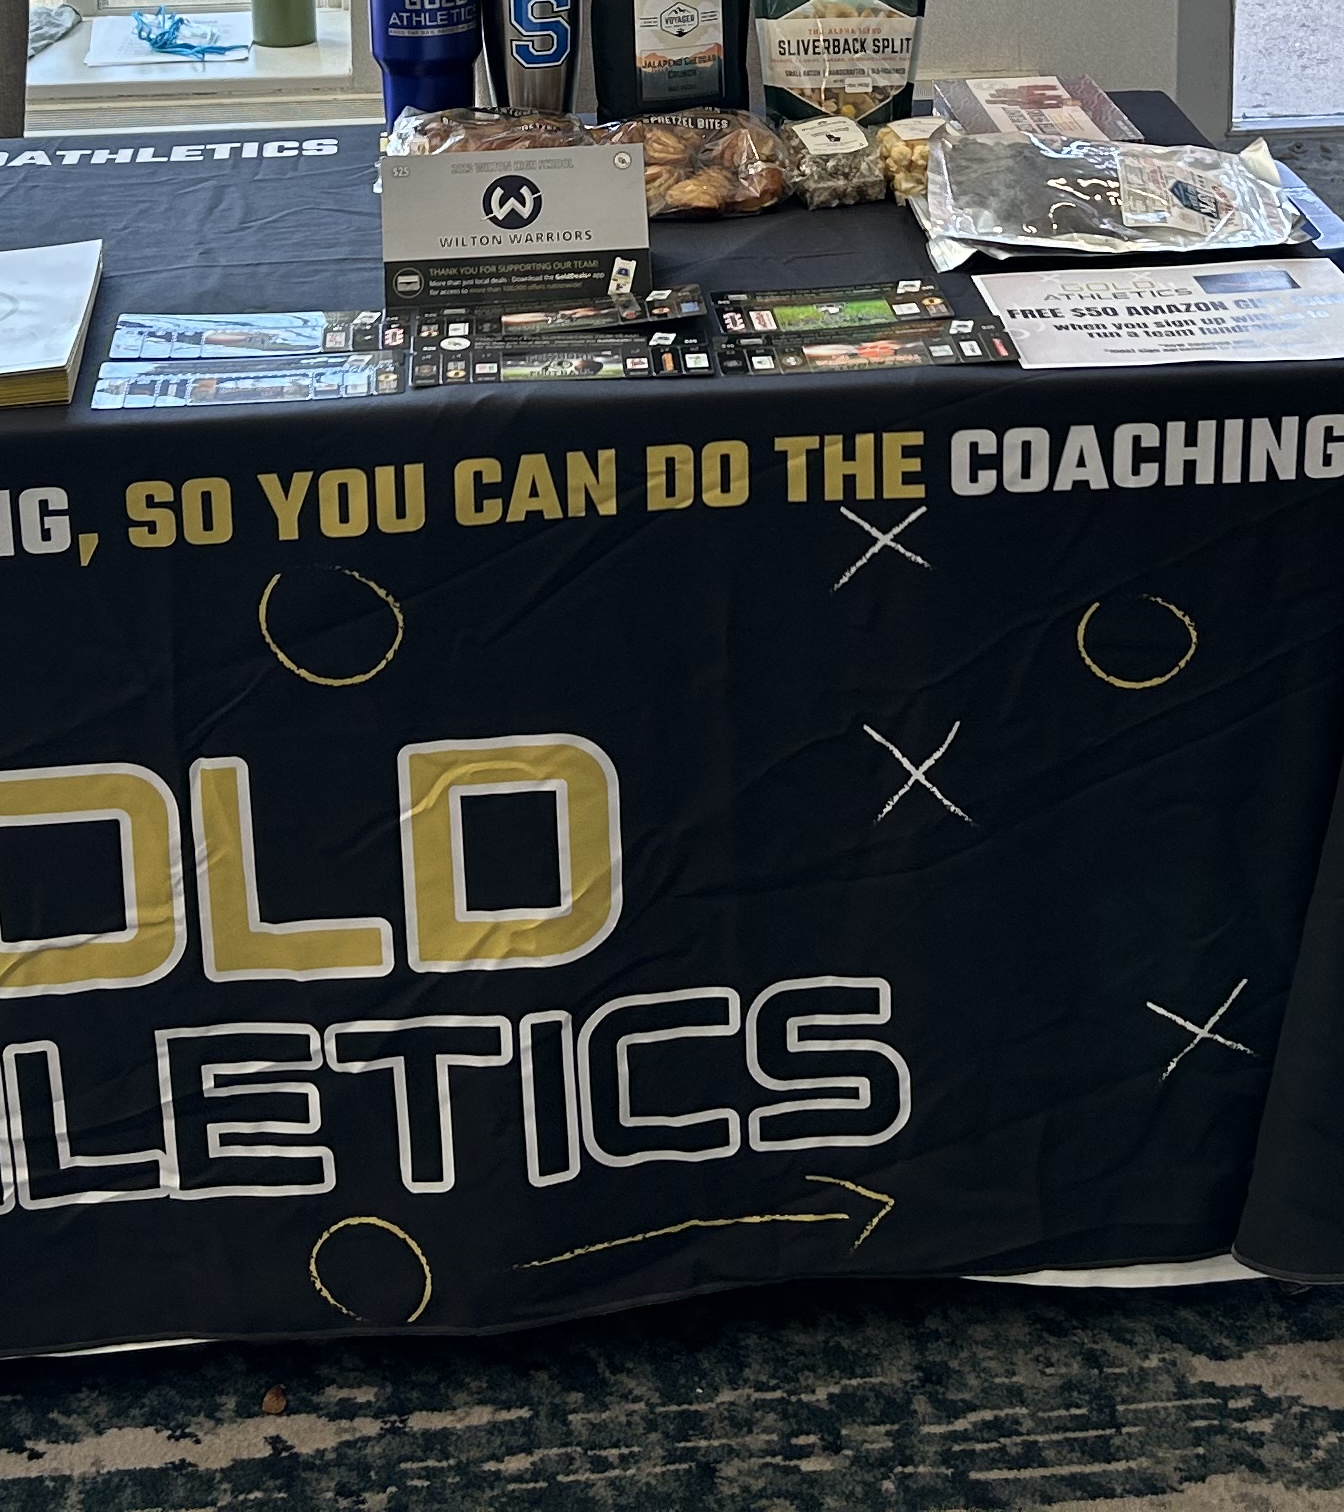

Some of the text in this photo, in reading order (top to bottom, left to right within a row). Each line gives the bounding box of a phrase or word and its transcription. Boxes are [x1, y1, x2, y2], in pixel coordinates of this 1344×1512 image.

[778, 37, 912, 56] SLIVERBACK SPLIT
[649, 116, 729, 130] PRETZEL BITES
[393, 167, 409, 176] $25
[440, 230, 593, 248] WILTON WARRIORS
[429, 268, 458, 276] THANK
[459, 267, 478, 275] YOU
[480, 266, 496, 274] FOR
[498, 263, 552, 273] SUPPORTING
[553, 262, 571, 270] OUR
[1059, 281, 1156, 292] GOLD
[1044, 288, 1192, 301] ATHLETICS
[1007, 308, 1065, 319] FREE
[1070, 307, 1119, 318] $50
[1128, 300, 1229, 316] AMAZON
[1054, 323, 1108, 331] when
[1111, 321, 1150, 330] you
[1153, 318, 1197, 328] sign
[1201, 317, 1226, 326] up
[1143, 329, 1195, 337] team
[126, 475, 232, 549] SO
[258, 464, 428, 542] YOU
[455, 447, 618, 527] CAN
[646, 440, 752, 513] DO
[773, 430, 926, 503] THE
